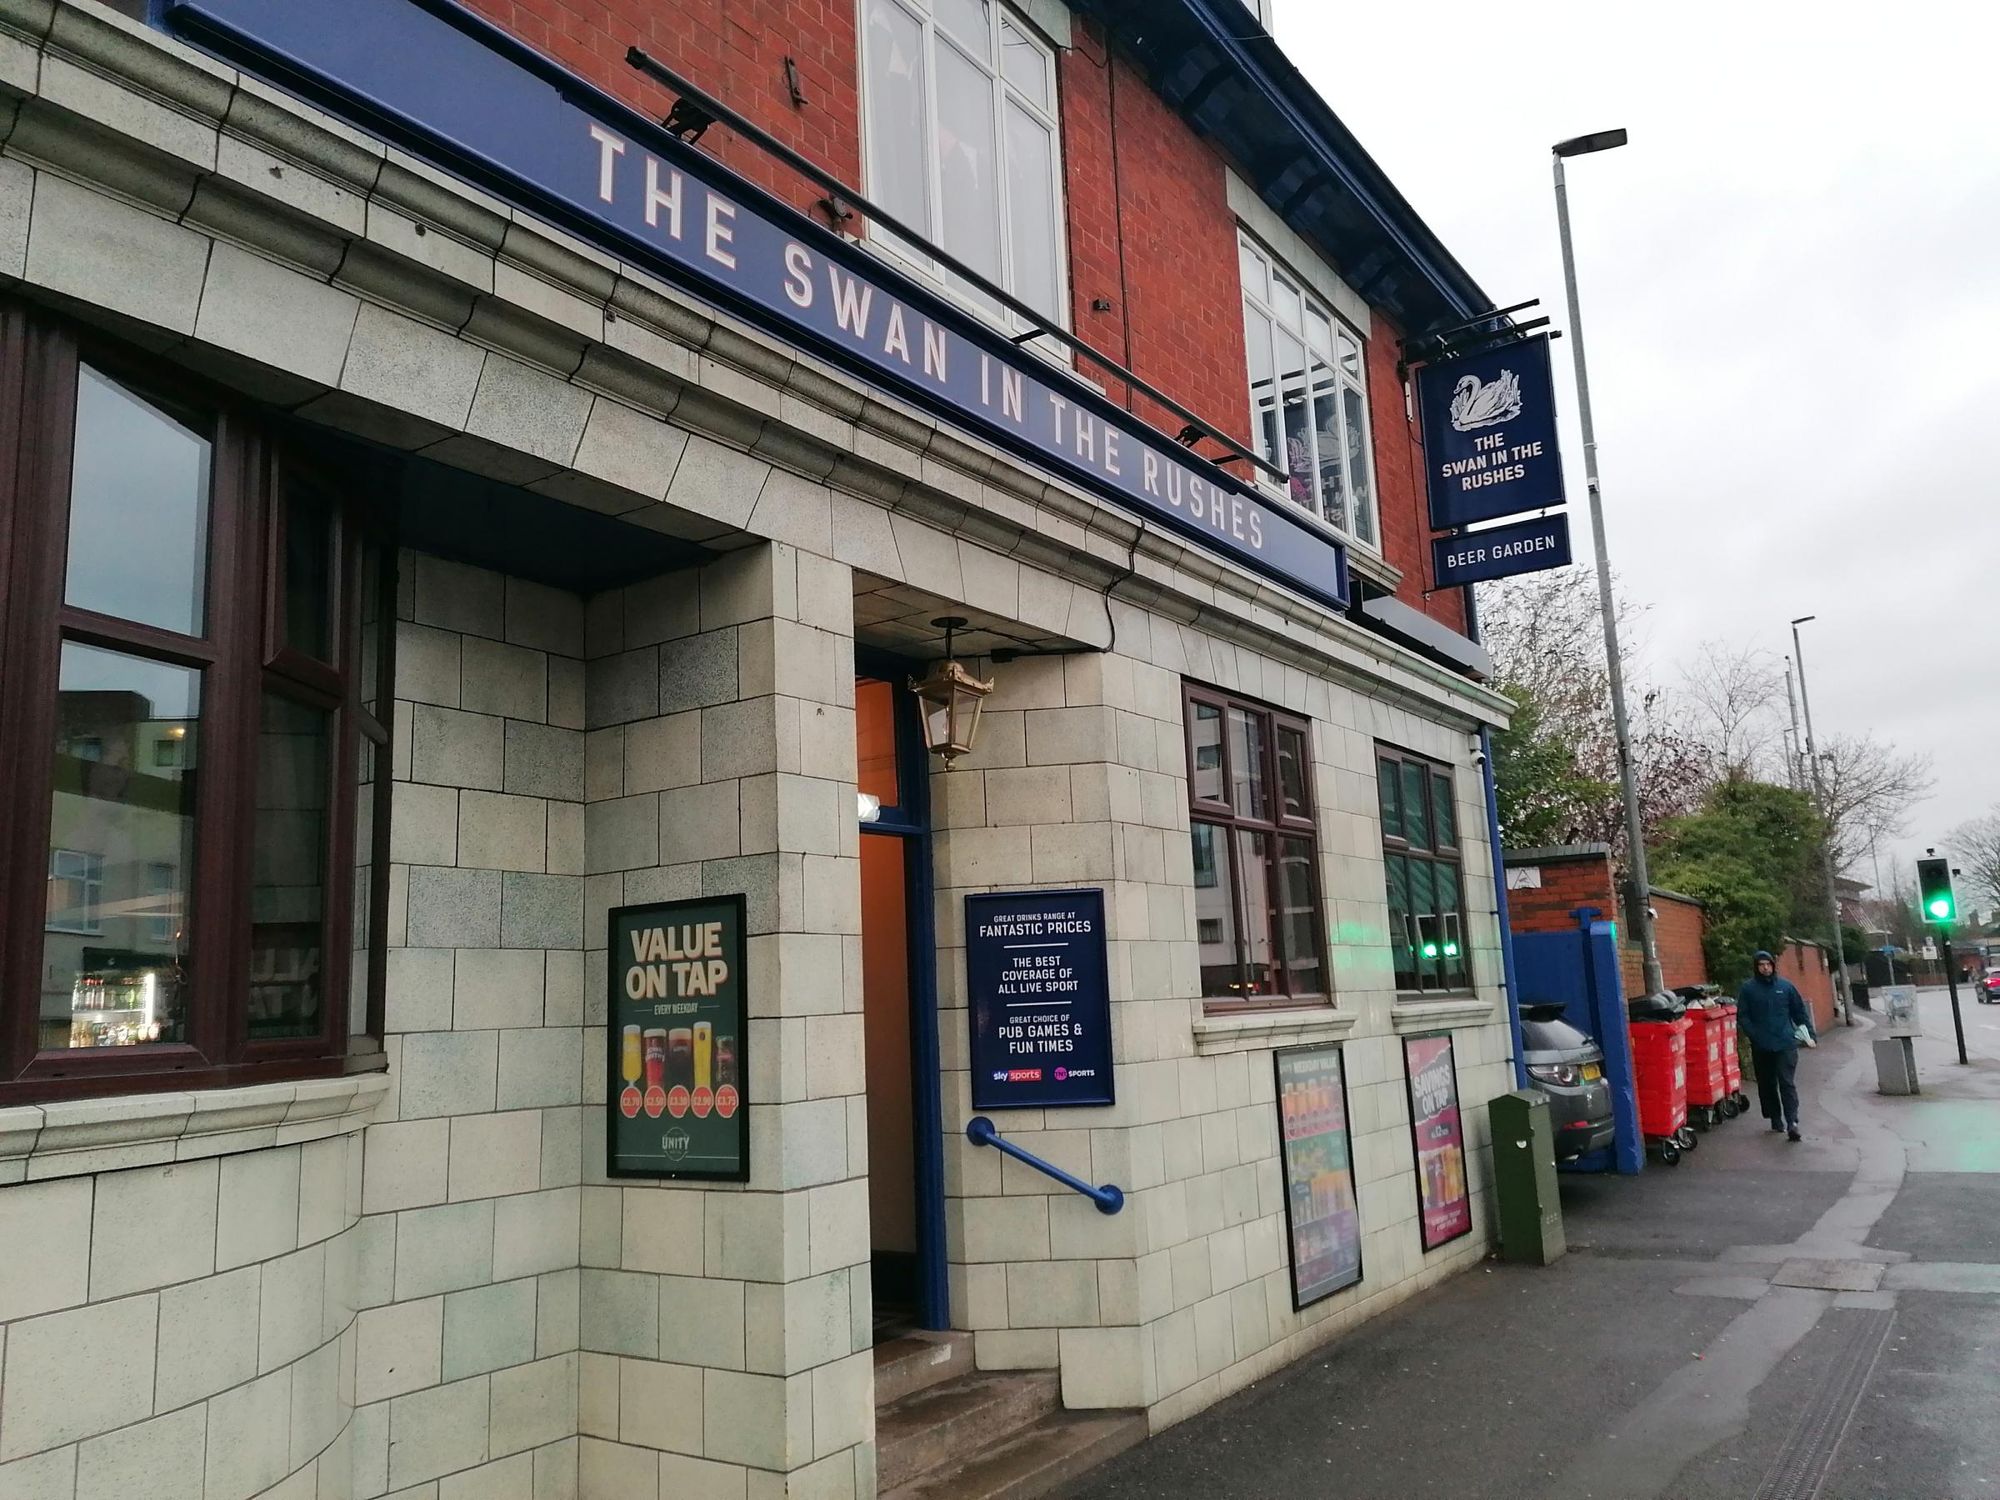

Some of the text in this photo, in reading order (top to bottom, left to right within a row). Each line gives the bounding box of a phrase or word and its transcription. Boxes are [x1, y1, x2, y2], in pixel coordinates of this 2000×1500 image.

[590, 123, 1263, 549] THE SWAN IN THE RUSHES
[1474, 432, 1504, 451] THE
[1442, 441, 1543, 478] SWAN IN THE
[1462, 464, 1525, 491] RUSHES
[1447, 535, 1555, 568] BEER GARDEN
[993, 911, 1076, 923] GREAT DRINKS RANGE AT
[980, 920, 1091, 937] FANTASTIC PRICES
[630, 921, 723, 963] VALUE
[1013, 956, 1061, 968] THE BEST
[625, 959, 729, 1001] ON TAP
[1002, 968, 1073, 981] COVERAGE OF
[998, 980, 1079, 994] ALL LIVE SPORT
[1009, 1014, 1070, 1024] GREAT CHOICE OF
[999, 1023, 1082, 1039] PUB GAMES &
[1009, 1040, 1073, 1054] FUN TIMES
[993, 1070, 1040, 1081] sky sports
[662, 1136, 690, 1150] UNITY
